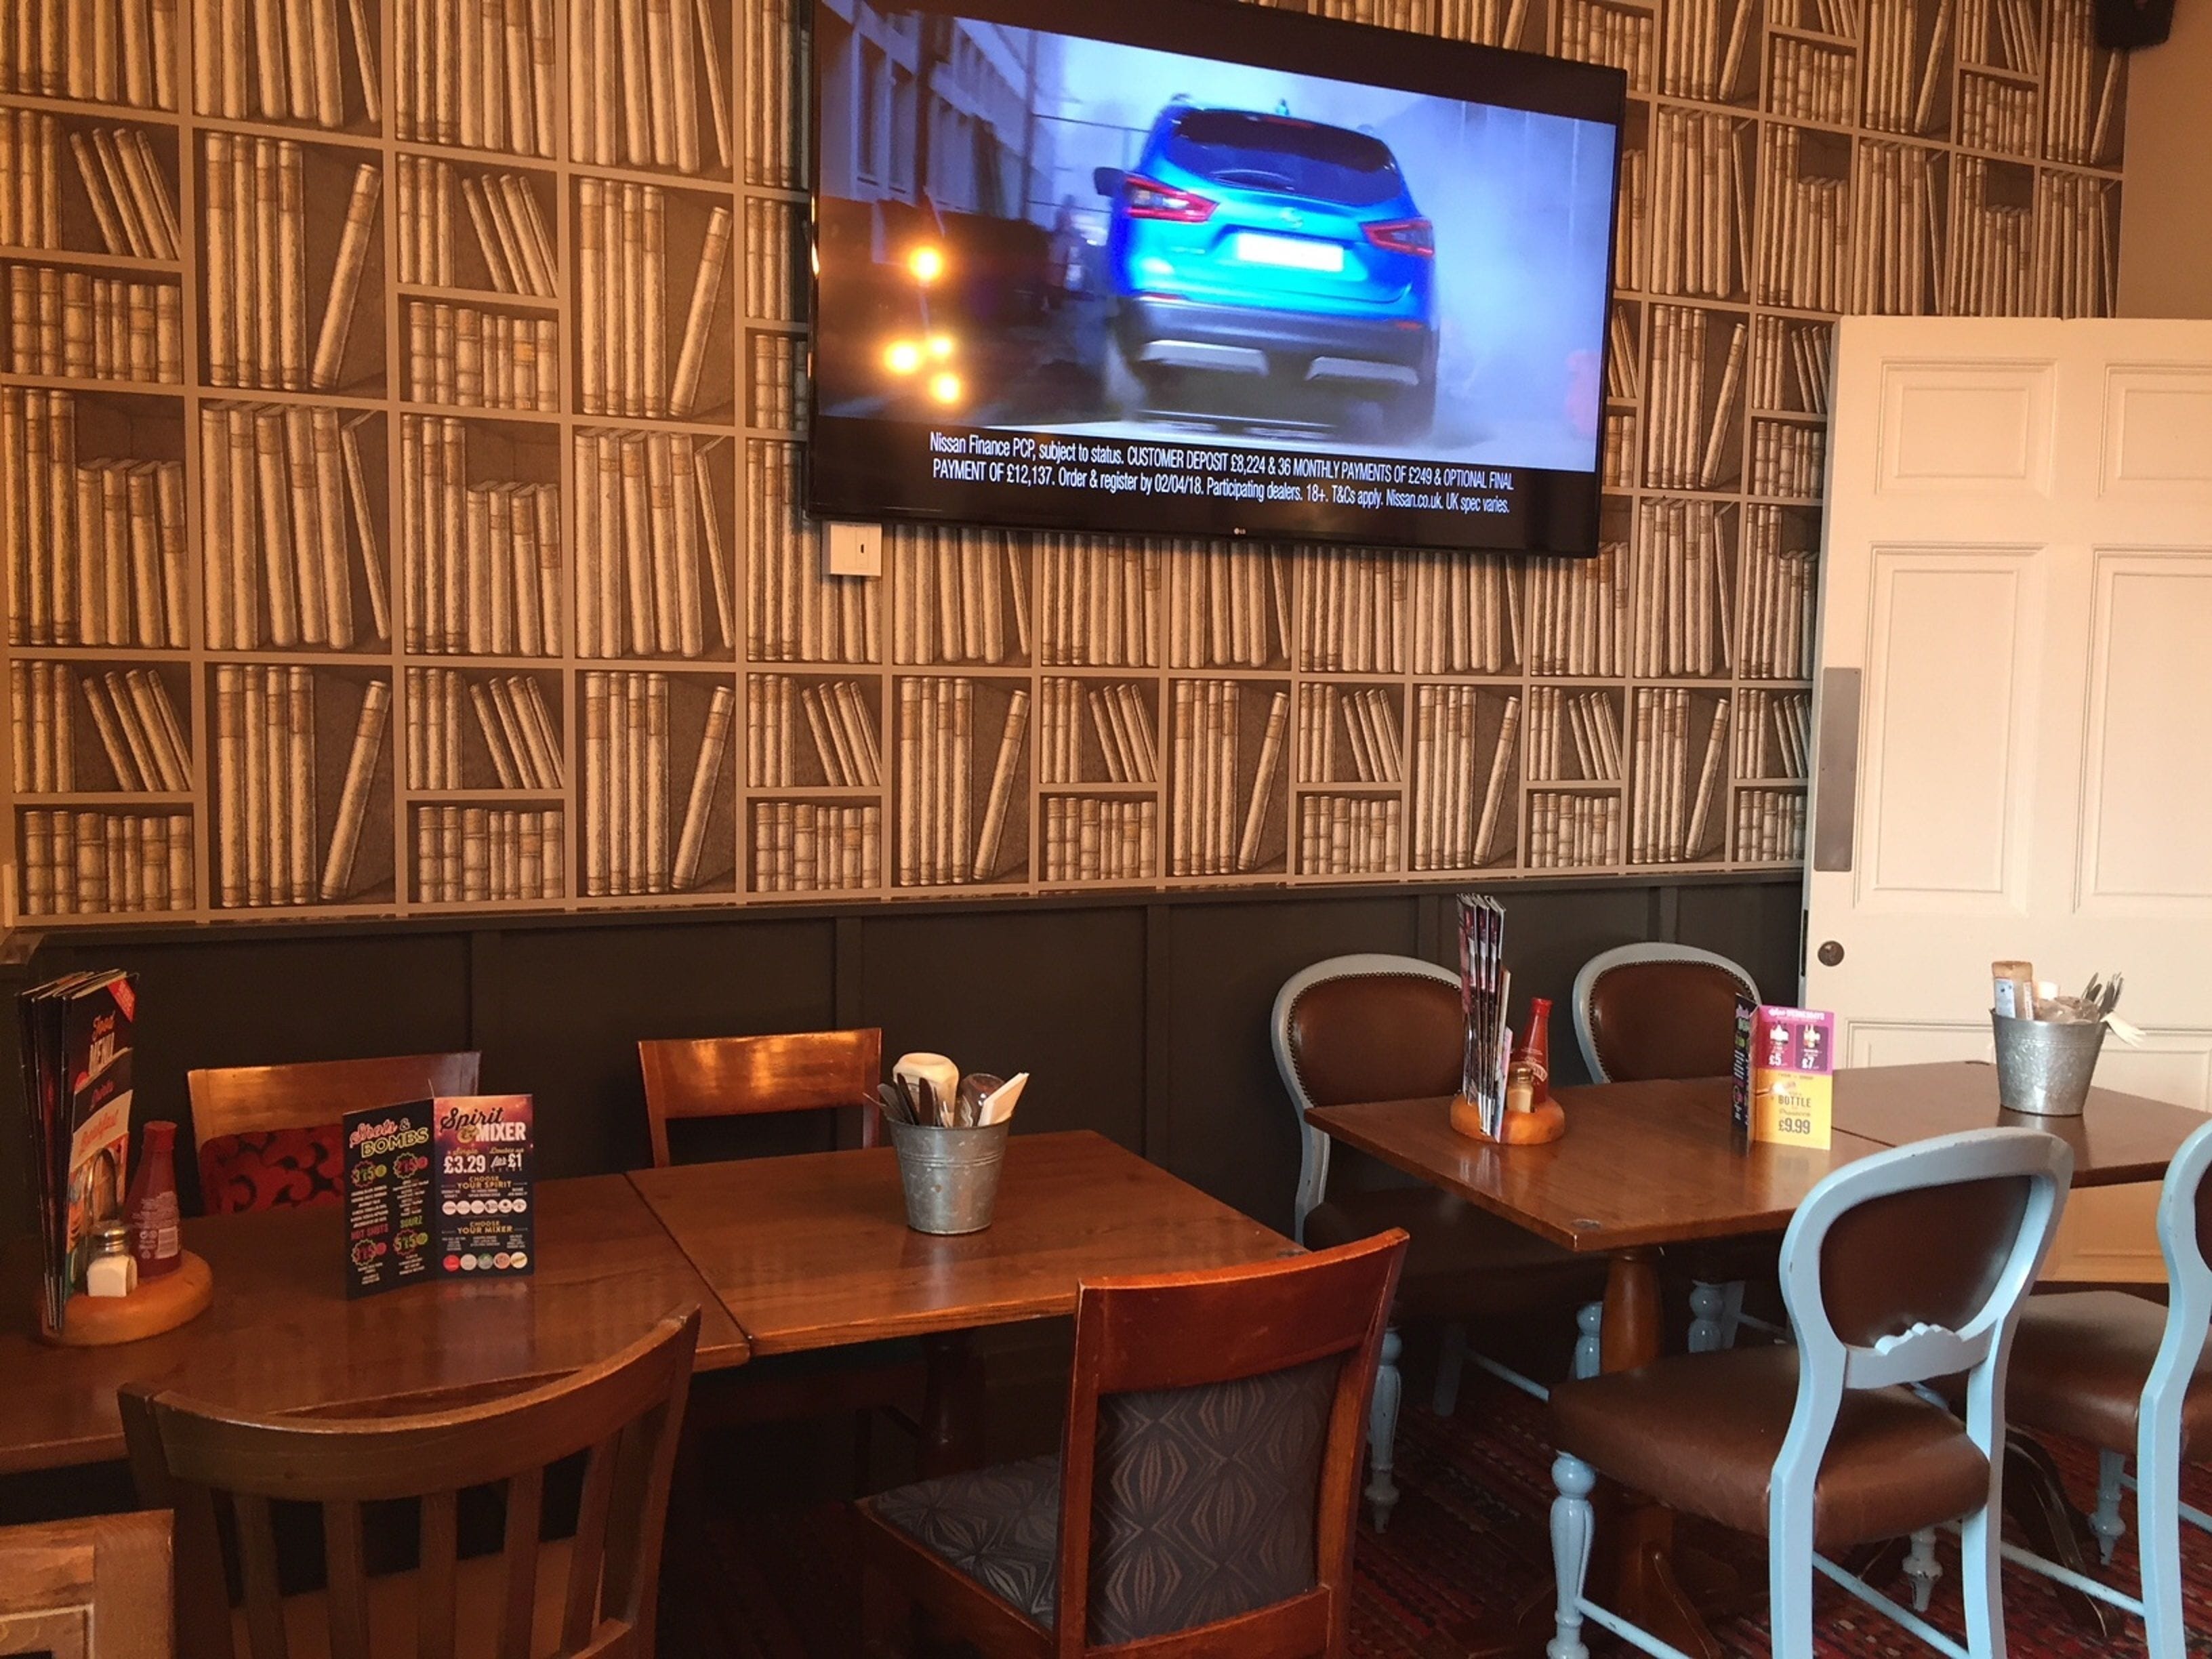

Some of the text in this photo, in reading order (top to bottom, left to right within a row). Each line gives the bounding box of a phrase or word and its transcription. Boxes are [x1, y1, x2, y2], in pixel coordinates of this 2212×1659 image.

[930, 431, 1514, 490] Nissan Finance PCP, subject to status. CUSTOMER DEPOSIT £8,224 & 36 MONTHLY PAYMENTS OF £249 & OPTIONAL FINAL
[933, 457, 987, 481] PAYMENT
[989, 462, 1005, 482] OF
[1006, 464, 1055, 487] £12,137.
[1058, 466, 1087, 487] Order
[1089, 468, 1099, 489] &
[1100, 471, 1138, 494] register
[1141, 472, 1152, 496] by
[1154, 472, 1204, 495] 02/04/18.
[1206, 476, 1265, 502] Participating
[1267, 481, 1303, 500] dealers.
[1307, 483, 1329, 502] 18+.
[1331, 485, 1355, 504] T&Cs
[1357, 487, 1383, 509] apply.
[1446, 492, 1459, 510] UK
[1460, 496, 1481, 514] spec
[1483, 495, 1510, 513] varies.
[1778, 1094, 1811, 1108] BOTTLE
[399, 1117, 411, 1132] &
[440, 1107, 504, 1134] Spirit
[1778, 1118, 1811, 1135] £9.99
[475, 1122, 526, 1142] MIXER
[361, 1126, 429, 1159] BOMBS
[443, 1154, 487, 1174] £3.29
[508, 1151, 523, 1168] £1
[456, 1180, 512, 1190] YOUR SPIRIT
[457, 1225, 513, 1235] YOUR MIXER
